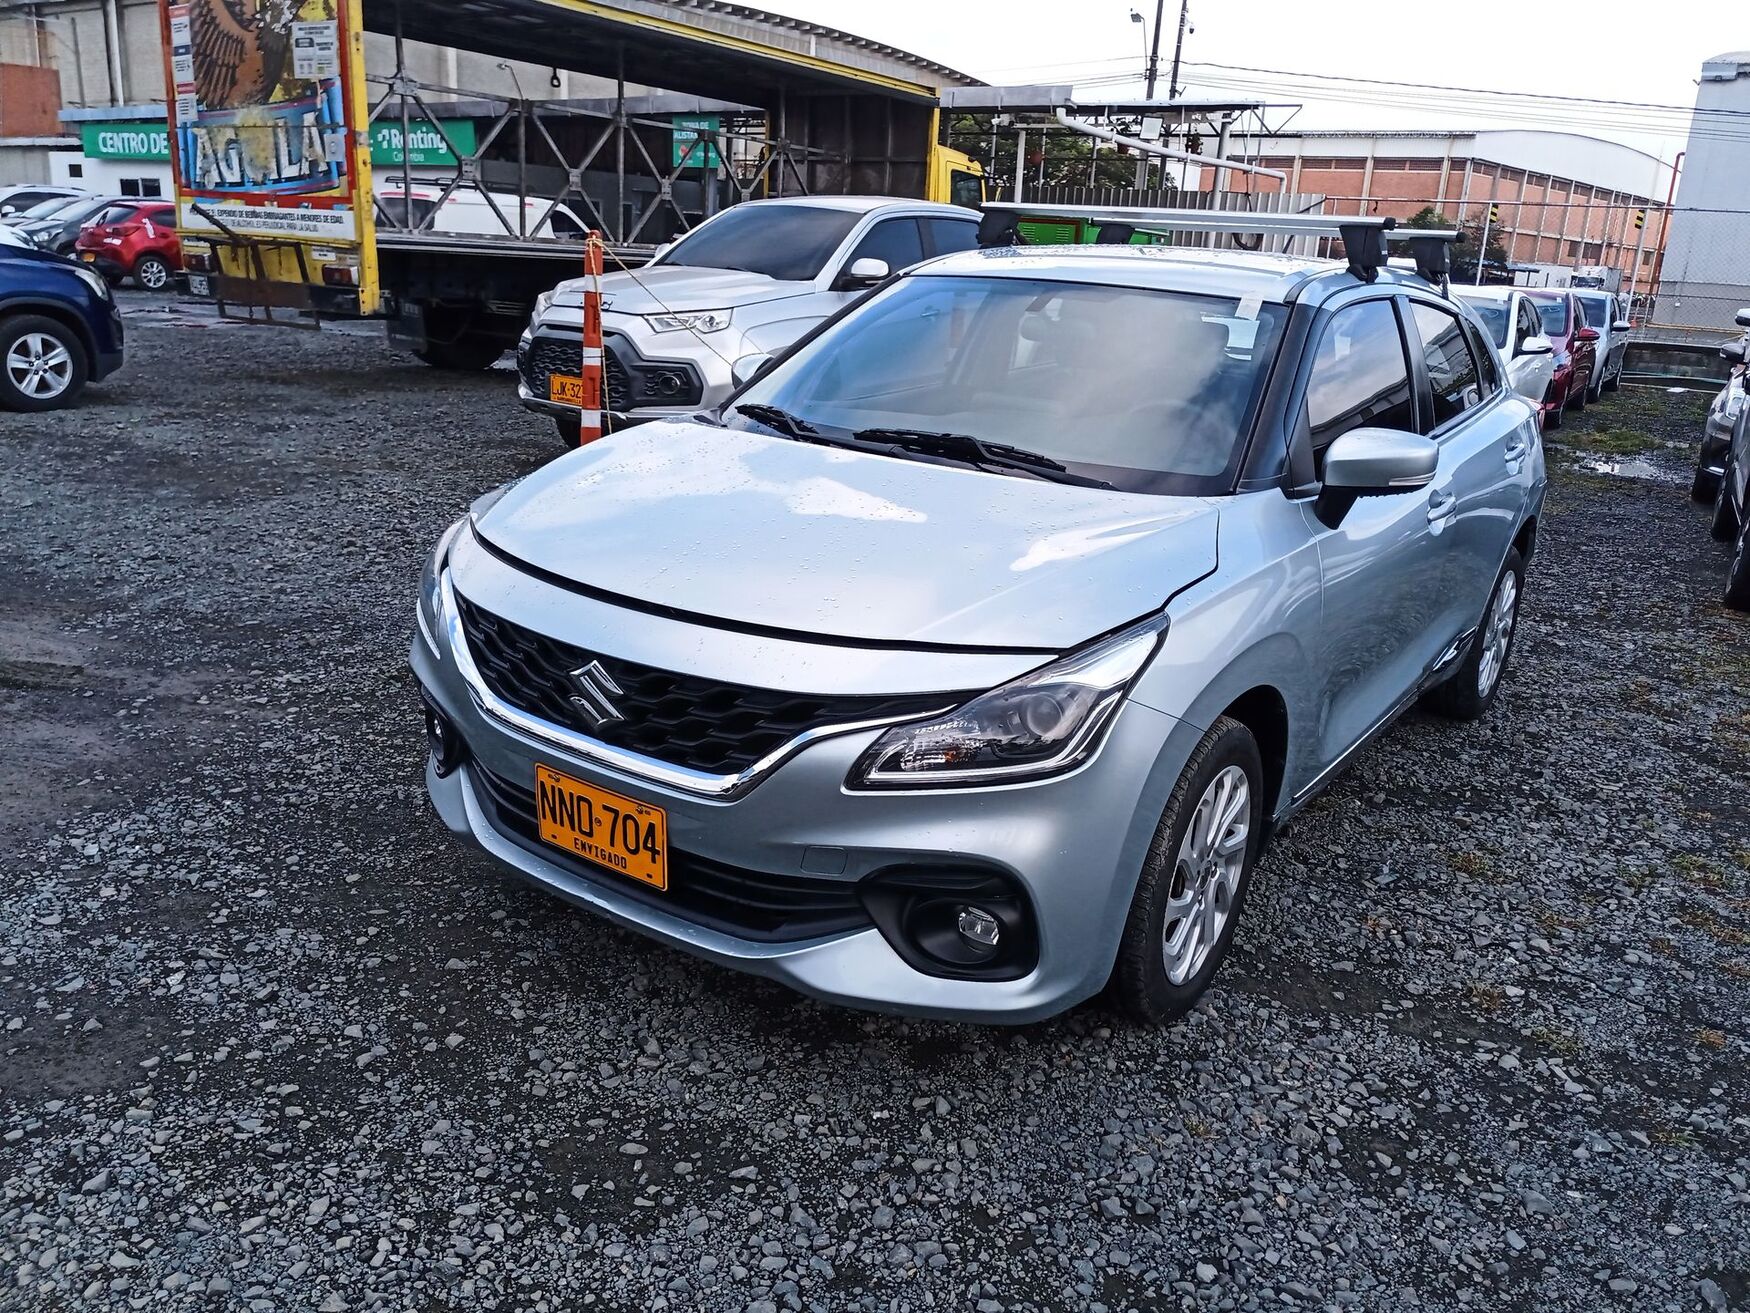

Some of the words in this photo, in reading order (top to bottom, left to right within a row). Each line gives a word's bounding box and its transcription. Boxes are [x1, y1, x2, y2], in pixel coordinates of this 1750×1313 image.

[98, 131, 148, 153] CENTRO
[149, 132, 169, 154] DE
[573, 836, 628, 870] ENVIGADO
